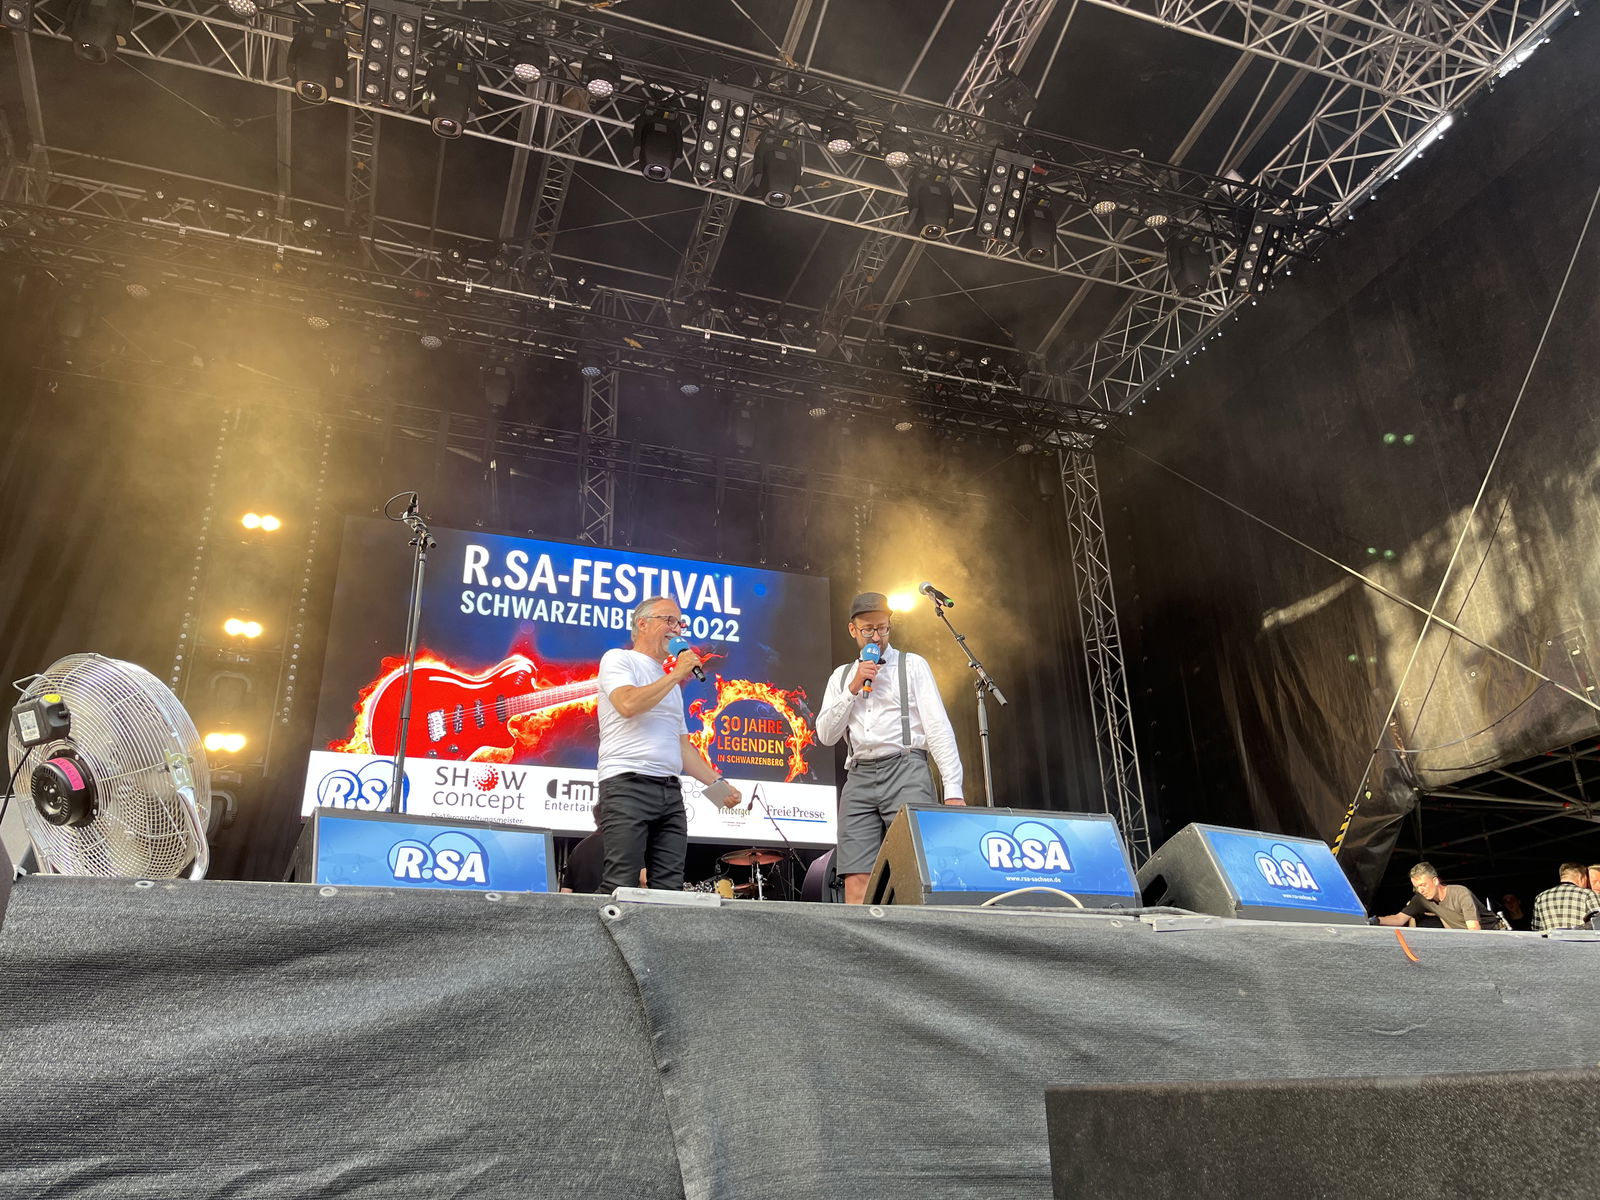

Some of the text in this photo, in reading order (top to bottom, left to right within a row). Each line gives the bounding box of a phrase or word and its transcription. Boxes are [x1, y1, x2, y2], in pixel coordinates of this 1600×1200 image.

[462, 544, 741, 615] R.SA-FESTIVAL
[460, 589, 740, 642] SCHWARZENBE 2022
[720, 715, 784, 736] 30 JAHRE
[717, 735, 785, 755] LEGENDEN
[717, 754, 784, 767] IN SCHWARZENBERG
[433, 790, 525, 814] concept
[393, 846, 487, 883] R.SA
[986, 837, 1072, 871] R.SA
[1257, 857, 1320, 890] R.SA
